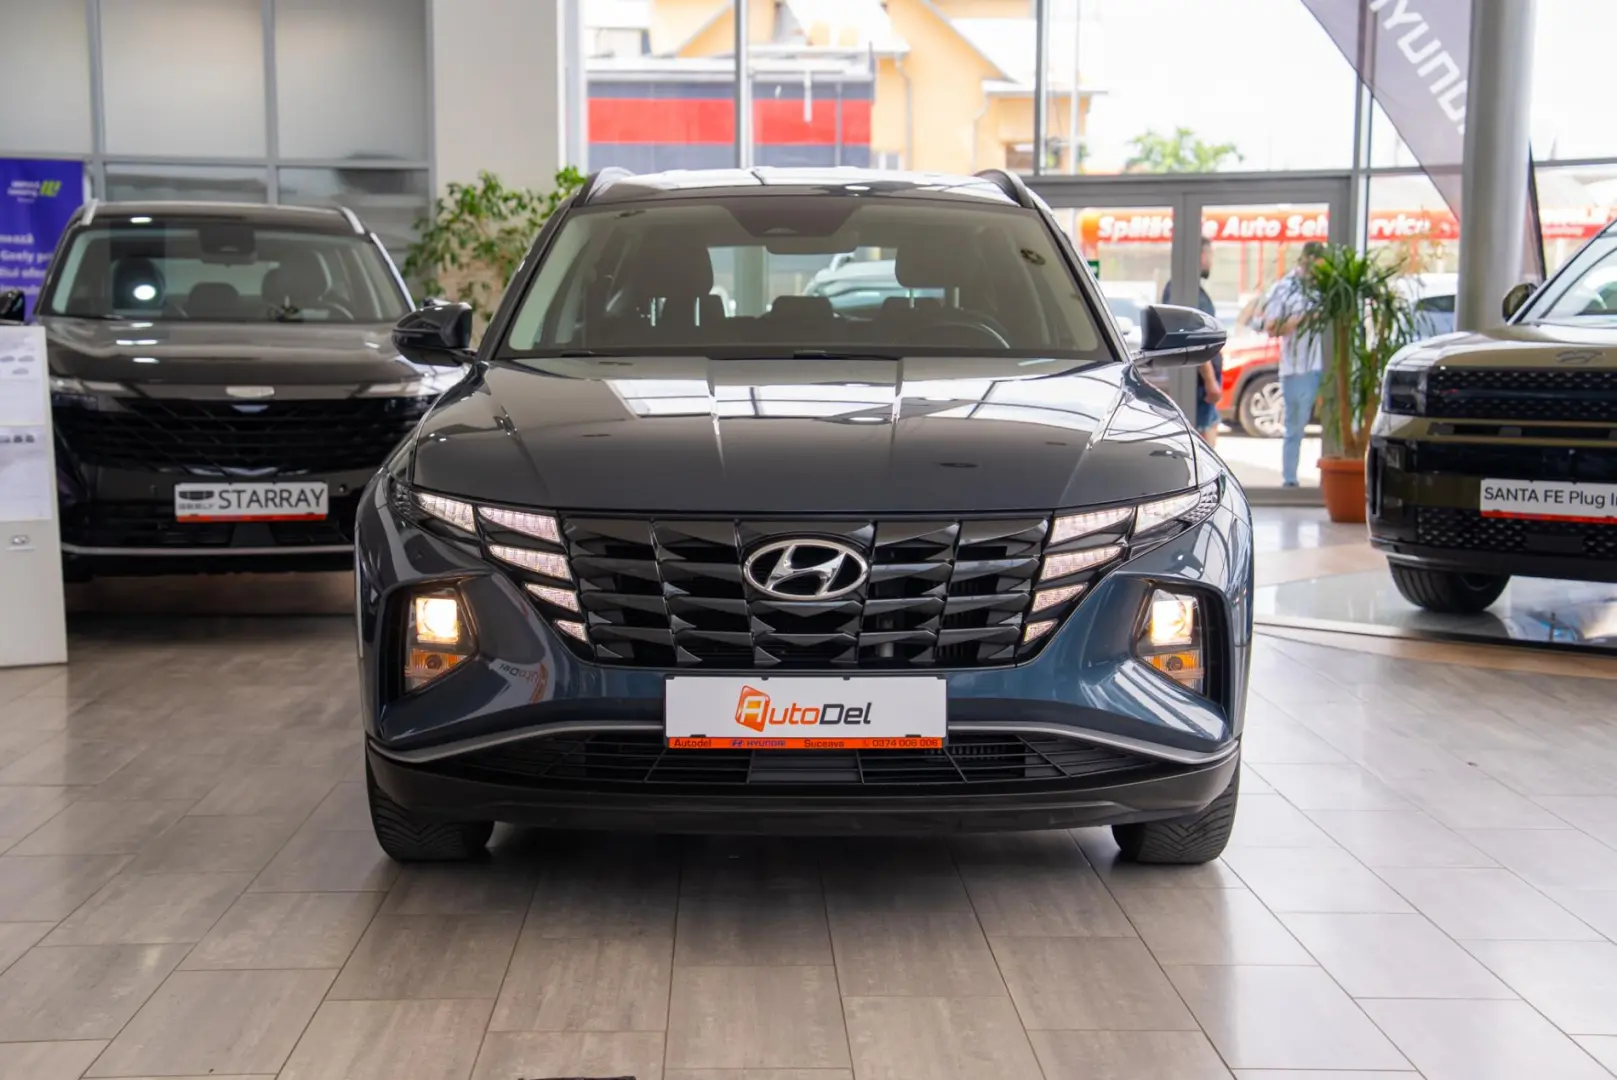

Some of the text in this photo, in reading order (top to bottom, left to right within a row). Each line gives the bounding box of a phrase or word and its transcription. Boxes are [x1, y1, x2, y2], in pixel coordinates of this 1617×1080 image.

[1221, 215, 1281, 238] Auto
[218, 488, 325, 510] STARRAY
[1484, 486, 1617, 509] SANTA FE Plug I
[735, 685, 872, 732] AutoDel
[674, 738, 712, 748] Autodel
[746, 739, 786, 747] HYUNDAI
[804, 739, 844, 748] Suceava
[872, 739, 897, 747] 0374
